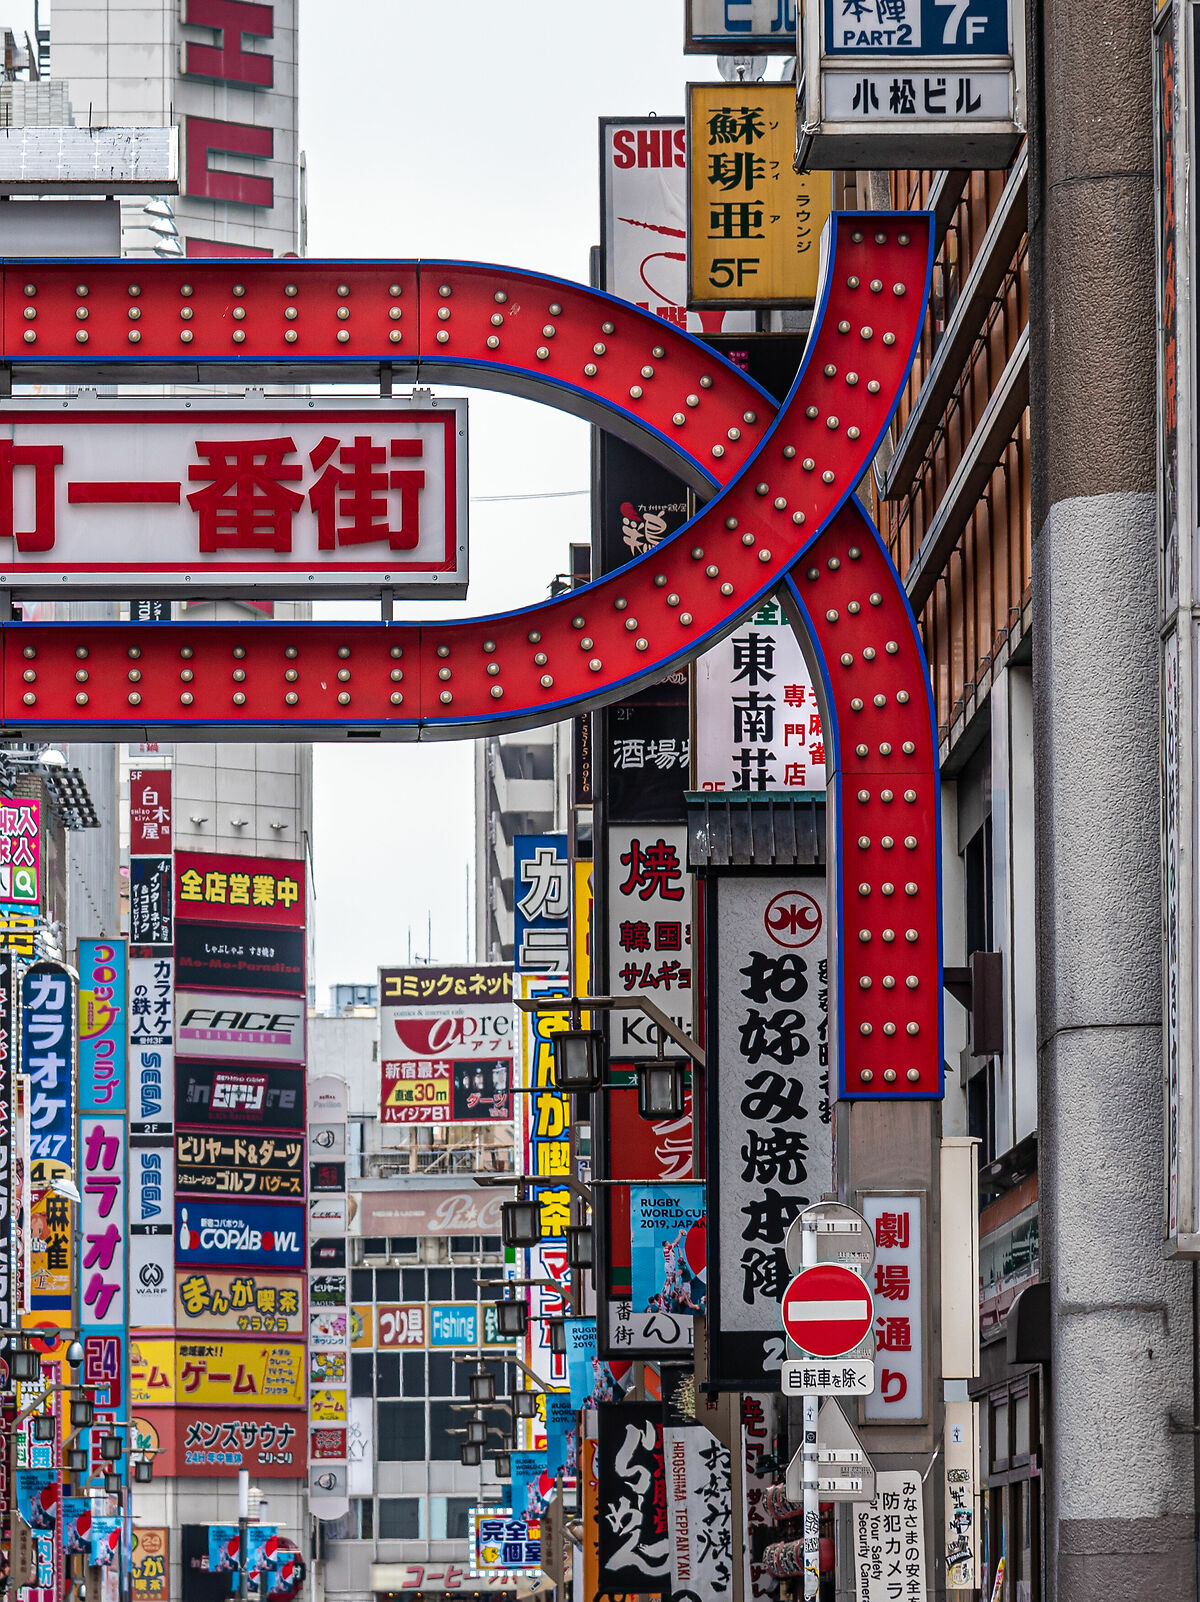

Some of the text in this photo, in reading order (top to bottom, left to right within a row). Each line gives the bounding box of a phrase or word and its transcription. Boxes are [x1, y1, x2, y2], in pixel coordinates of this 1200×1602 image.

[843, 24, 913, 46] PART2
[942, 0, 988, 45] 7F
[853, 78, 982, 115] 小松ビル
[707, 107, 766, 239] 蘇琲亜
[708, 258, 760, 288] 5F
[730, 633, 776, 791] 東南荘
[783, 684, 806, 787] 専門店
[131, 771, 142, 780] 5F
[141, 786, 171, 840] 白木屋
[620, 839, 685, 901] 焼
[180, 869, 299, 908] 全店営業中
[150, 873, 160, 941] インターネット
[205, 943, 244, 955] しゃぶしゃぶ
[619, 921, 691, 952] 韓国
[153, 960, 172, 1034] カラオケ
[385, 973, 513, 998] コミック&ネット
[132, 985, 152, 1035] の鉄人
[180, 1009, 300, 1033] FACE
[29, 975, 66, 1130] カラオケ
[385, 1062, 449, 1079] 新宿最大
[141, 1052, 162, 1118] SEGA
[144, 1124, 158, 1133] 2F
[737, 950, 810, 1305] お好み焼本陣
[30, 1134, 67, 1158] 747
[177, 1136, 302, 1167] ビリヤード&ダーツ
[141, 1153, 162, 1220] SEGA
[260, 1176, 301, 1193] バグース
[640, 1198, 681, 1207] RUGBY
[80, 1125, 122, 1319] カラオケ
[144, 1226, 158, 1234] 1F
[640, 1209, 706, 1218] WORLD CUP
[640, 1220, 706, 1230] 2019, JAPAN
[45, 1196, 69, 1270] 麻雀
[181, 1275, 299, 1317] まんが喫茶
[874, 1212, 912, 1403] 劇場通り
[238, 1317, 289, 1333] ゲラゲラ
[380, 1309, 424, 1345] つり具
[433, 1310, 474, 1346] Fishing
[87, 1340, 117, 1379] 24
[131, 1366, 171, 1388] ーム
[181, 1360, 258, 1394] ゲーム
[789, 1367, 868, 1389] 自転車を除く
[185, 1421, 296, 1449] メンズサウナ
[672, 1441, 687, 1502] HIROSHIMA
[482, 1520, 528, 1542] 完全
[858, 1513, 870, 1558] Security
[870, 1516, 883, 1581] Your Safety
[883, 1492, 903, 1599] 防犯カメラ
[502, 1542, 541, 1564] 個室
